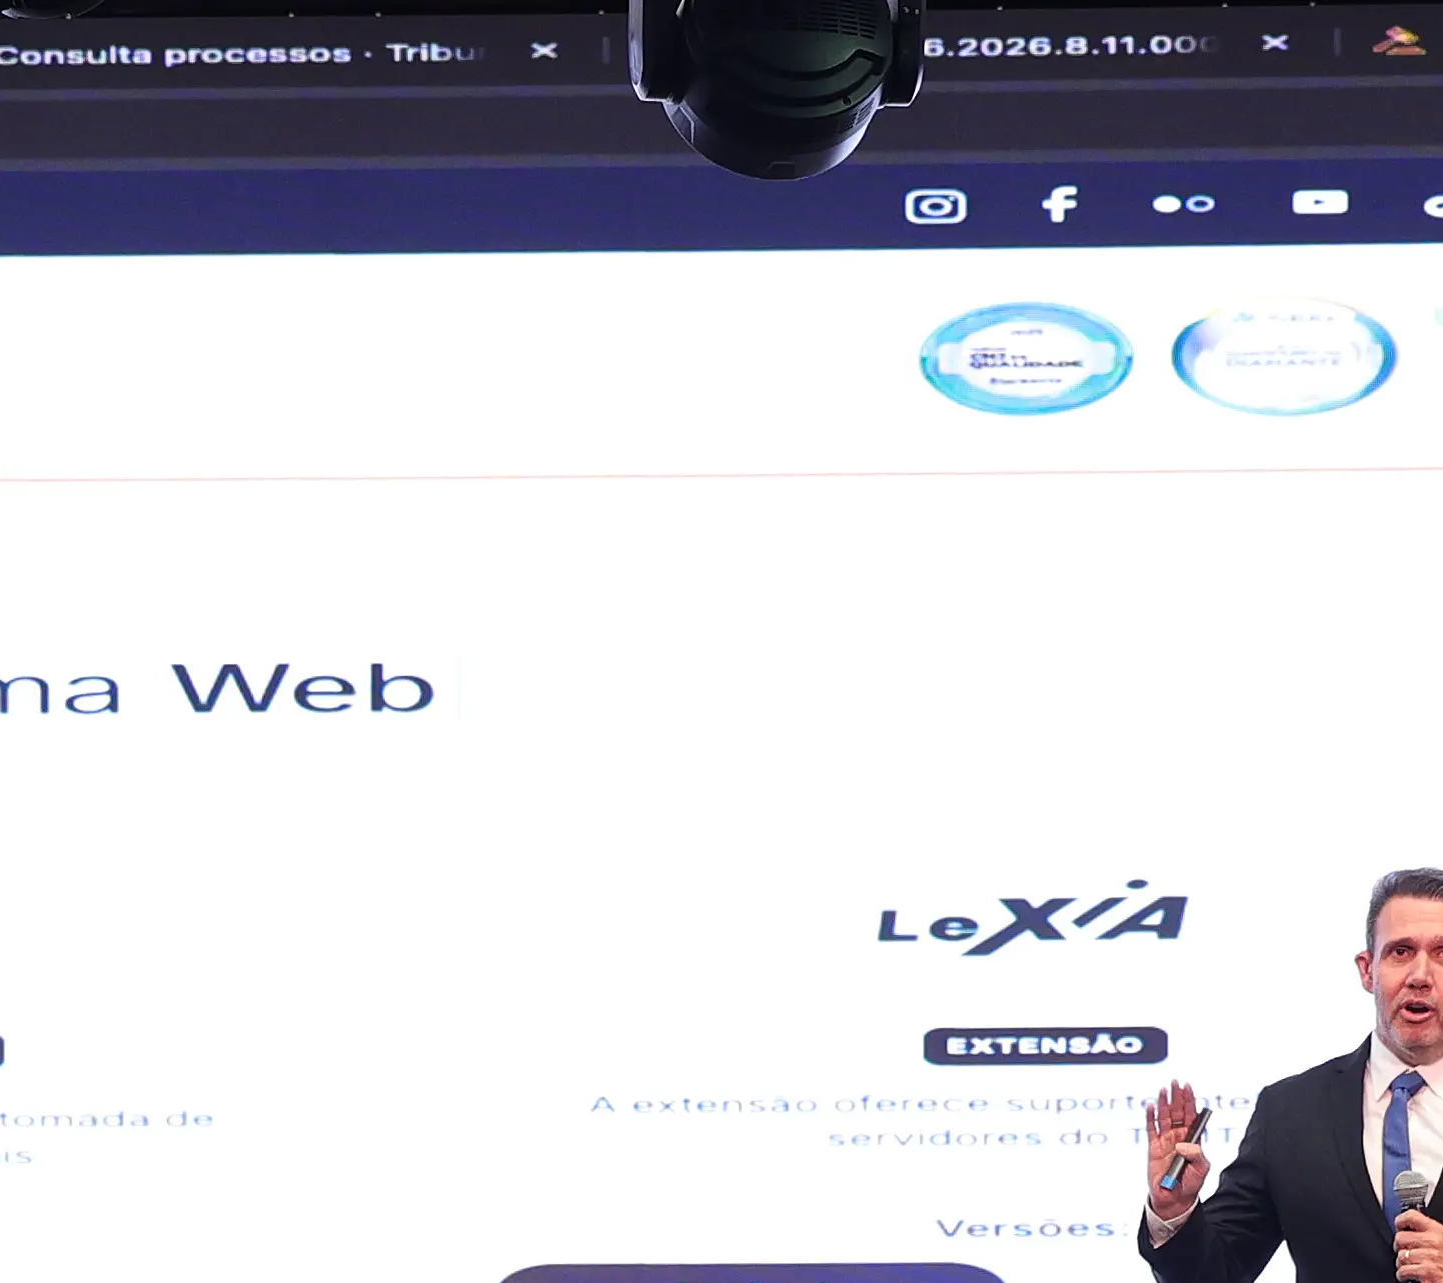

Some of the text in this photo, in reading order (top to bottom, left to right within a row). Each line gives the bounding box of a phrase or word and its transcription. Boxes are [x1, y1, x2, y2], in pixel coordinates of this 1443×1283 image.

[164, 47, 352, 67] processos
[171, 663, 433, 713] Web
[947, 1033, 1143, 1055] EXTENSÃO
[591, 1097, 615, 1112] A
[633, 1098, 816, 1112] extensão
[835, 1095, 988, 1111] oferece
[0, 1111, 149, 1127] tomada
[167, 1111, 213, 1126] de
[829, 1130, 1041, 1146] servidores
[1059, 1129, 1107, 1144] do
